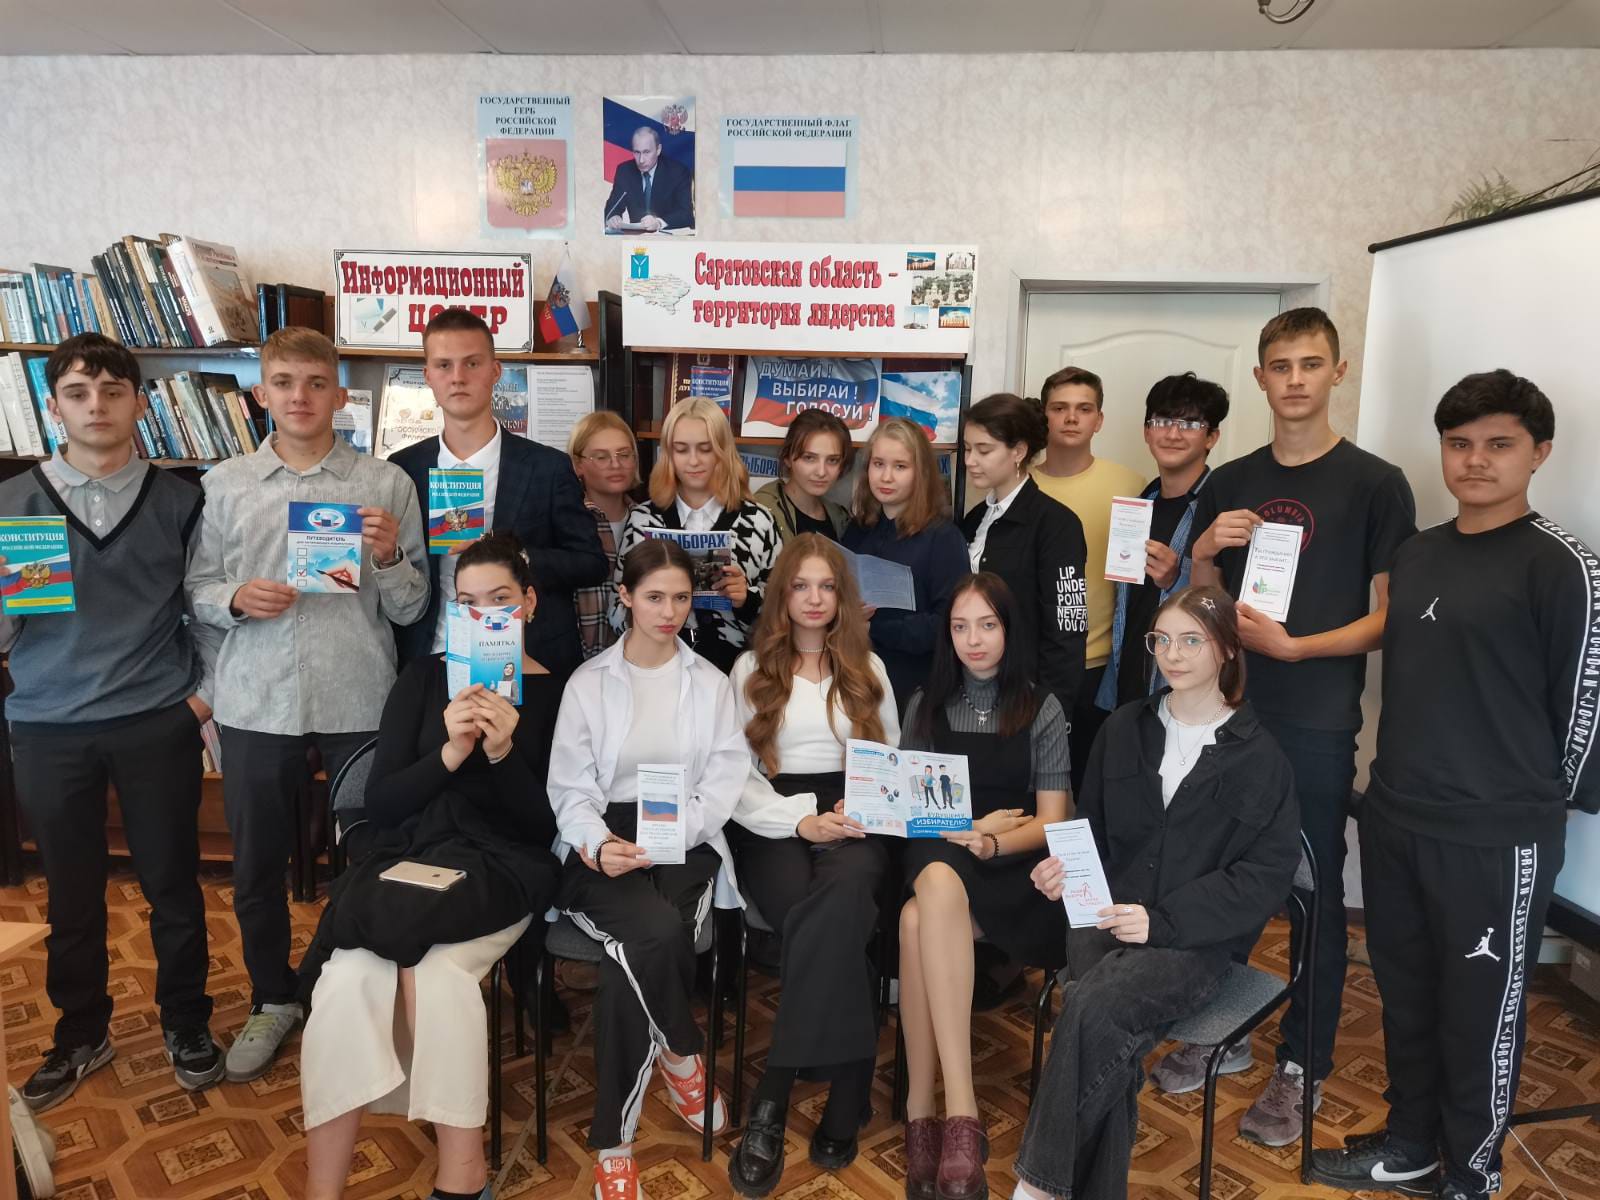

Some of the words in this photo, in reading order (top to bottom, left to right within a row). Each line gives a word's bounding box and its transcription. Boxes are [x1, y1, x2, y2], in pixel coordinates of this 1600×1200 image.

[480, 96, 570, 106] ГОСУДАРСТВЕННЫЙ
[514, 106, 536, 115] ГЕРБ
[495, 116, 557, 125] РОССИЙСКОЙ
[726, 118, 822, 128] ГОСУДАРСТВЕННЫЙ
[824, 119, 852, 128] ФЛАГ
[500, 127, 555, 136] ФЕДЕРАЦИИ
[727, 128, 792, 138] РОССИЙСКОЙ
[794, 128, 852, 139] ФЕДЕРАЦИИ
[694, 252, 803, 290] Саратовская
[809, 255, 882, 289] область
[340, 261, 525, 300] Информационный
[693, 299, 802, 330] территория
[807, 303, 896, 332] лидерства
[853, 386, 858, 400] !
[868, 405, 874, 421] !
[430, 482, 481, 490] КОНСТИТУЦИЯ
[1059, 566, 1076, 580] LIP
[1056, 578, 1086, 594] UNDE
[1057, 608, 1088, 620] NEVER
[1058, 618, 1078, 632] YOU
[1571, 700, 1595, 752] JORDAN
[916, 818, 967, 827] ИЗБИРАТЕЛЮ
[1520, 848, 1532, 895] ORDAN
[1514, 910, 1526, 962] JORDAN
[1497, 1036, 1512, 1086] JORDAN
